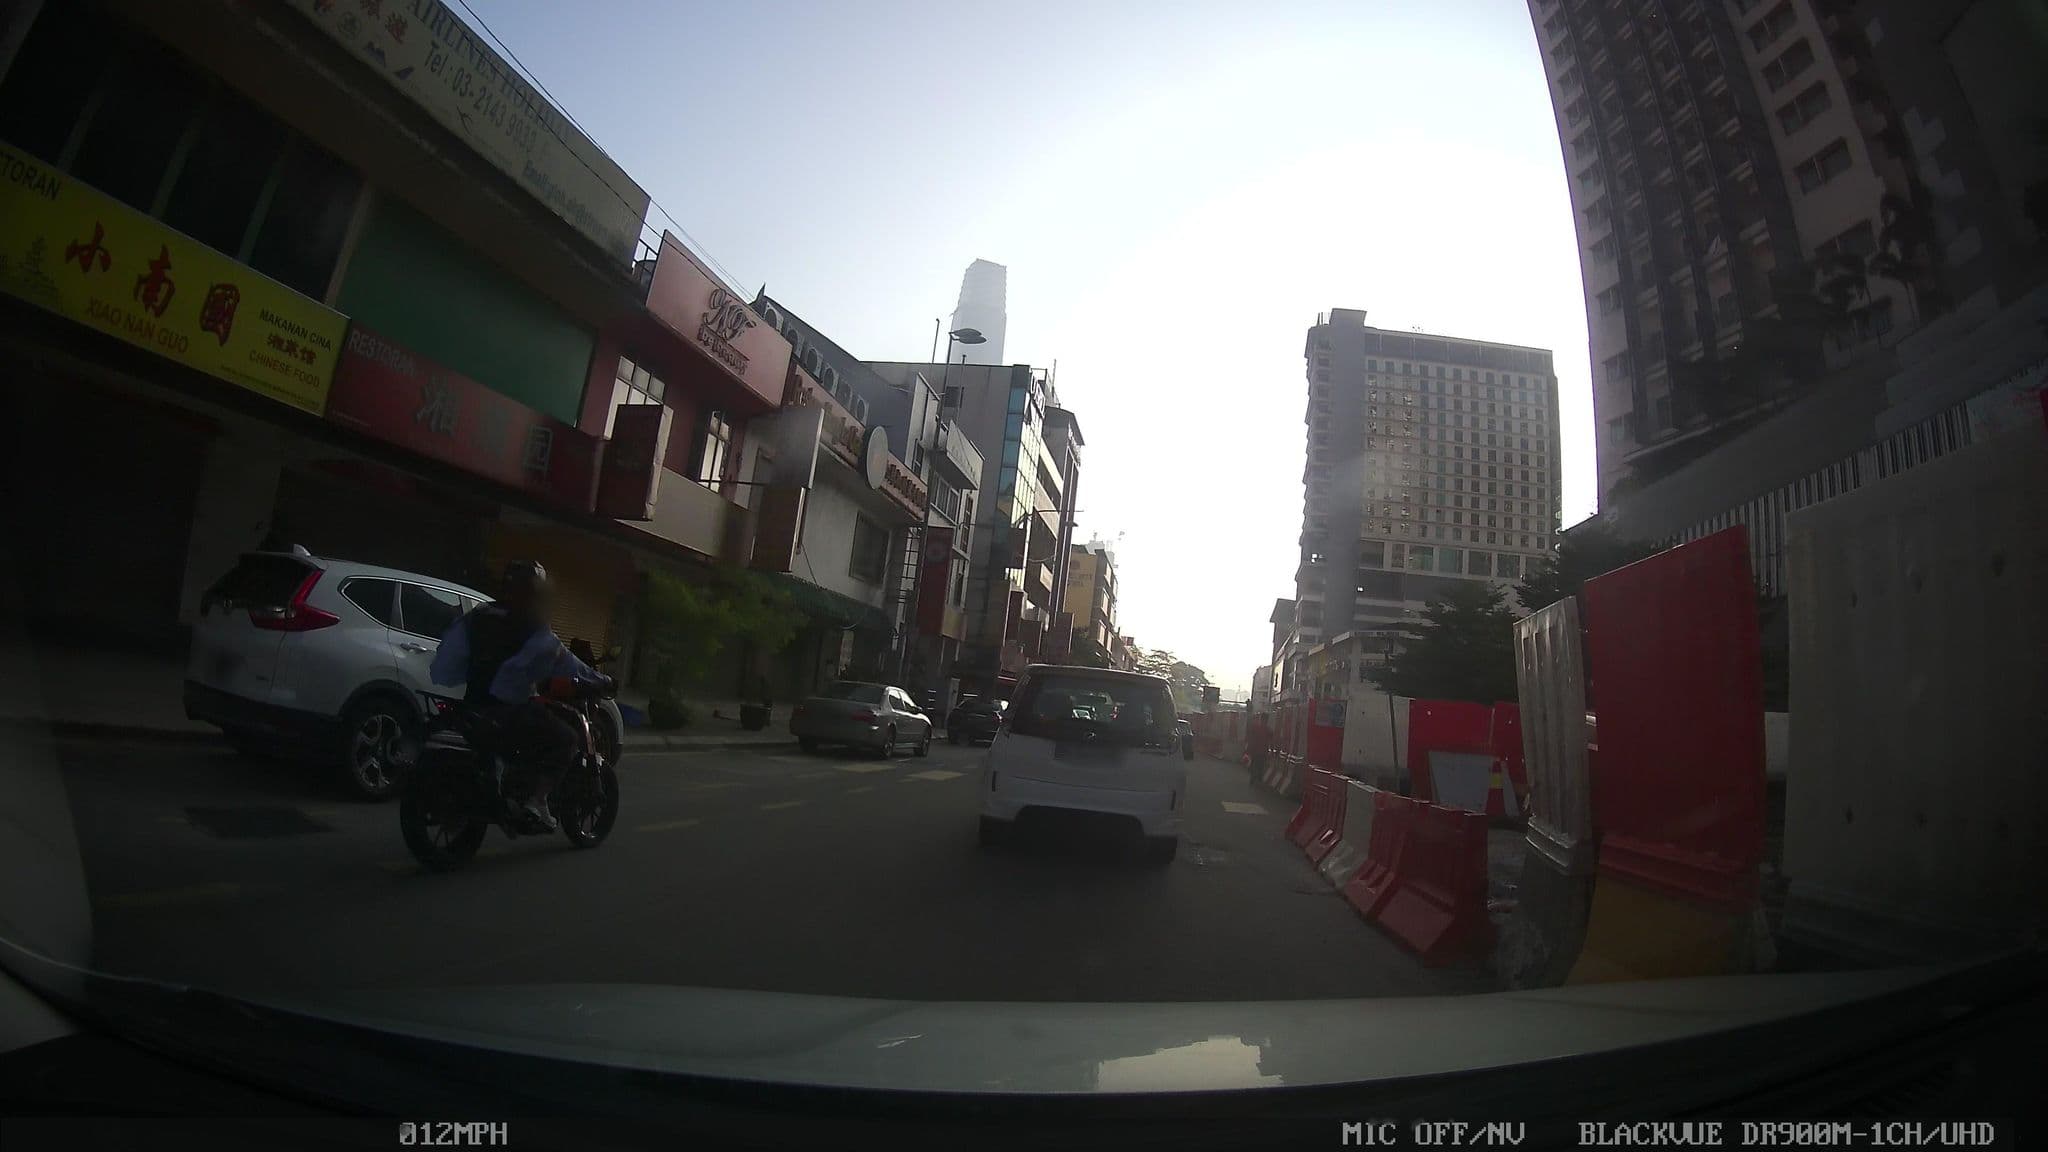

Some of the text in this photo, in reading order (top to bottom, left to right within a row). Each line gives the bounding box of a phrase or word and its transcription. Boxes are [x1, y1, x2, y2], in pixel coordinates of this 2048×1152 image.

[86, 296, 189, 354] XIAO NAN GUO
[259, 307, 332, 353] MAKANAN CINA
[248, 348, 292, 378] CHINESE
[293, 366, 320, 389] FOOD
